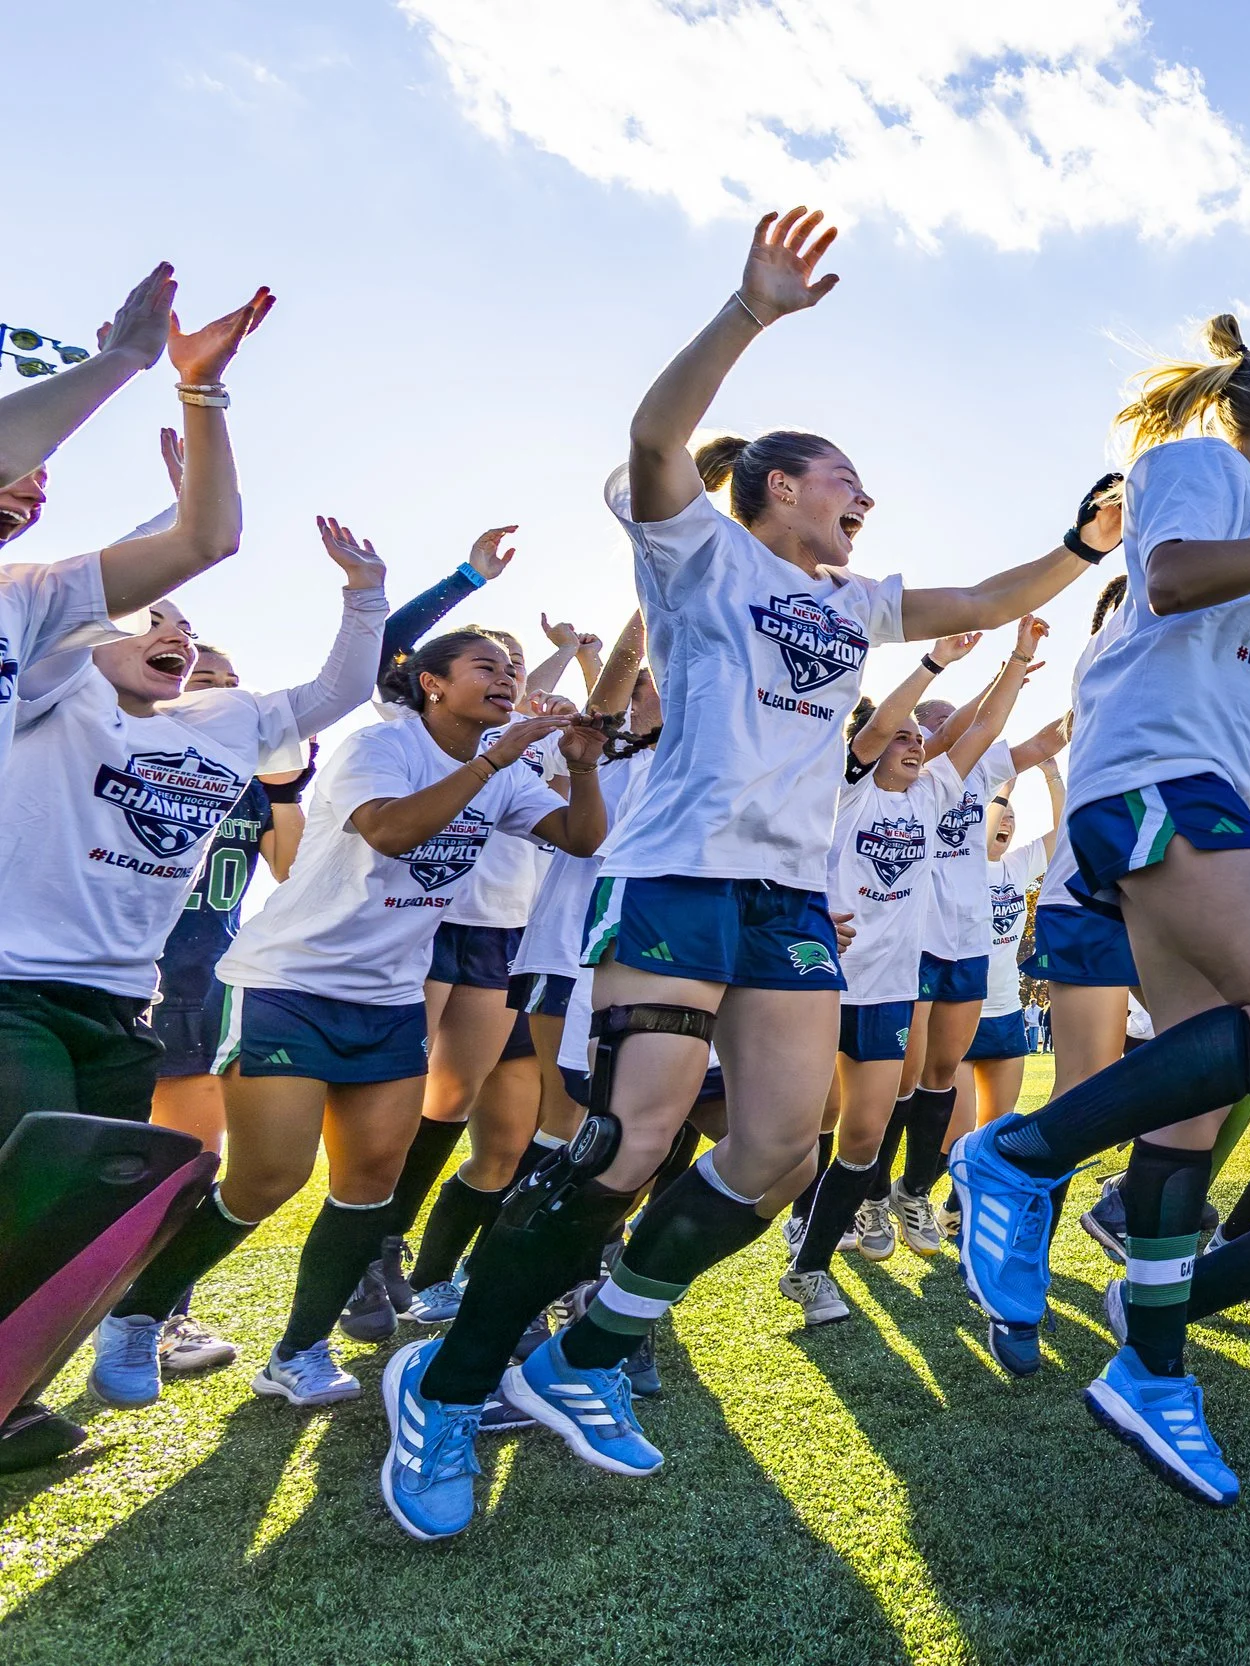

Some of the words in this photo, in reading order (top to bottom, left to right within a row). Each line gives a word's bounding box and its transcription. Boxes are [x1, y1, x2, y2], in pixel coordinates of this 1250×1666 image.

[793, 607, 821, 621] NEW
[791, 621, 814, 632] 2025
[757, 687, 835, 721] #LEADASONE
[150, 764, 208, 780] CONFERENCE
[137, 768, 167, 782] NEW
[167, 774, 229, 794] ENGLAND
[157, 790, 181, 801] FIELD
[183, 796, 222, 808] HOCKEY
